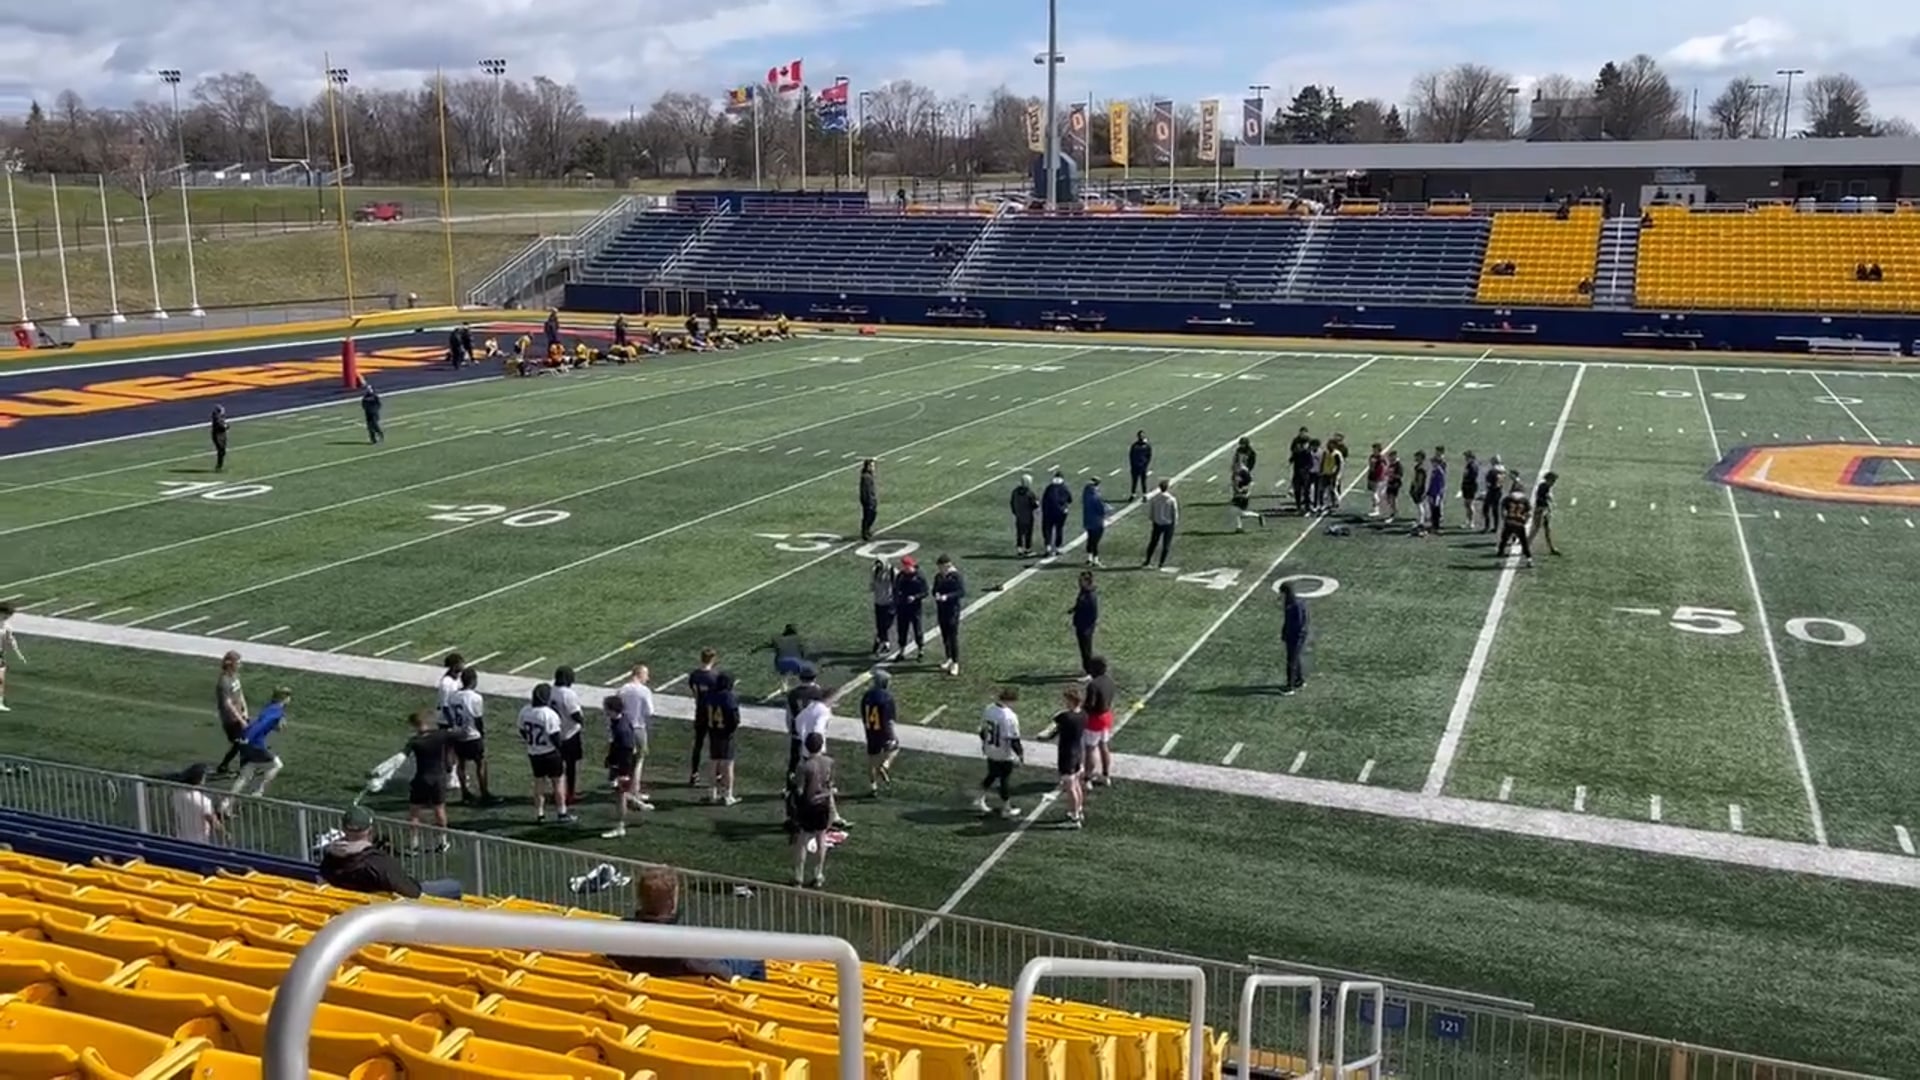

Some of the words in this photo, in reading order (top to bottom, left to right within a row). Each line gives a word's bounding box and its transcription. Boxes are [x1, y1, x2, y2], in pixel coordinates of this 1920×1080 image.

[425, 504, 571, 527] 20
[765, 532, 920, 559] 30
[1176, 567, 1341, 598] 40
[1669, 605, 1867, 647] 50
[707, 703, 725, 729] 14
[865, 703, 882, 731] 14
[1440, 1019, 1459, 1033] 121
